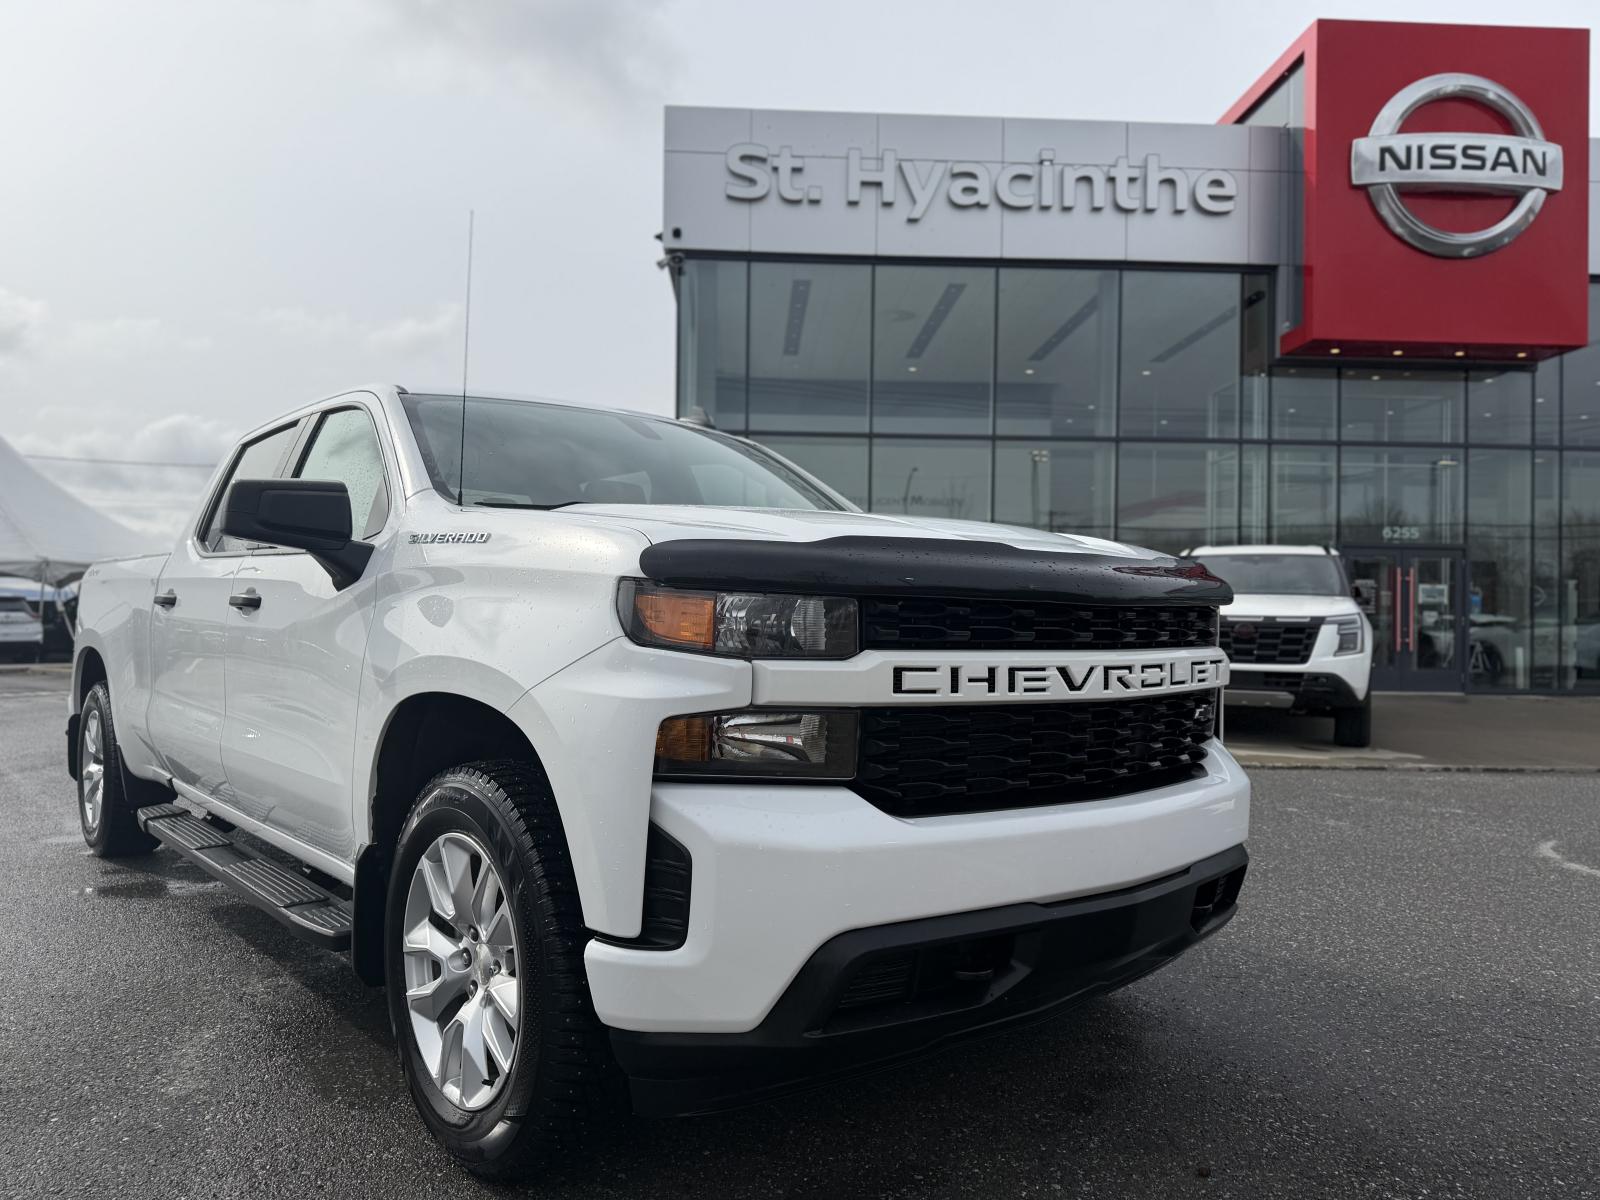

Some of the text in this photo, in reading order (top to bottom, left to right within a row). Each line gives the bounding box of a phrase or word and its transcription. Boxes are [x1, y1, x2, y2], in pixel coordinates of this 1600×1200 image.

[1378, 143, 1548, 177] NISSAN
[725, 142, 1239, 223] St. Hyacinthe
[408, 532, 492, 545] SILVERADO
[1382, 526, 1420, 540] 6255
[892, 658, 1227, 696] CHEVROLET
